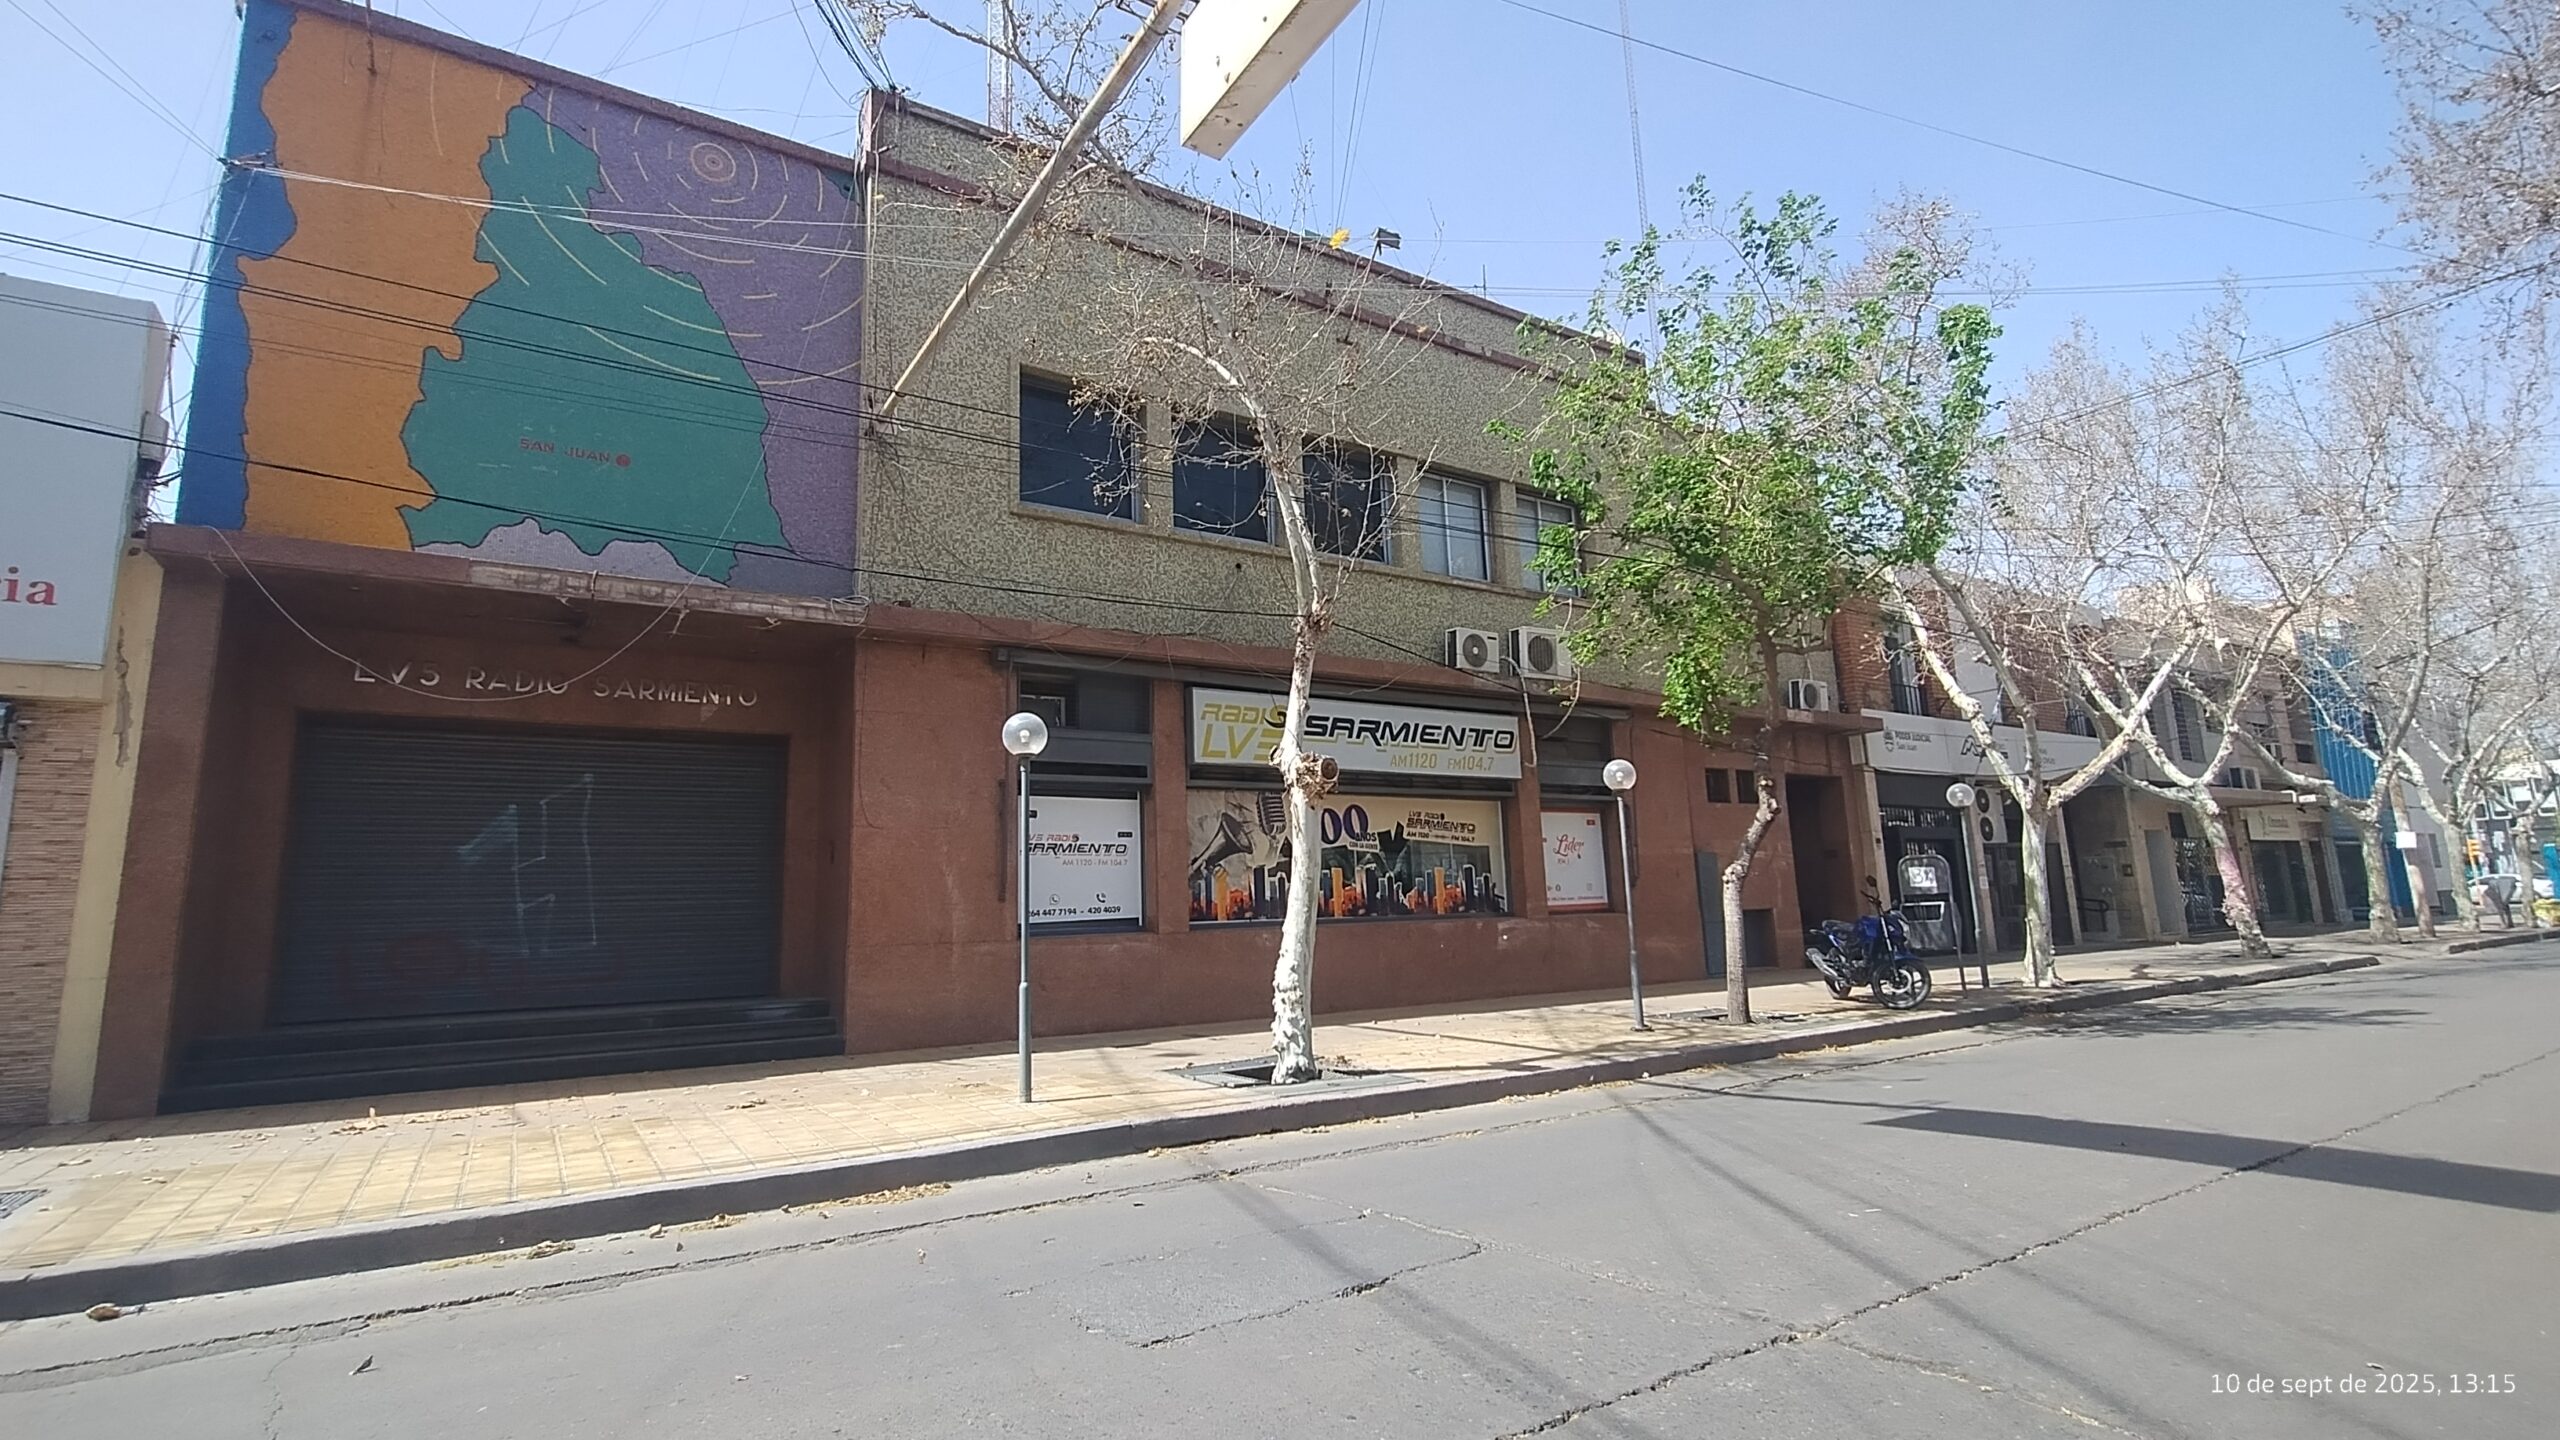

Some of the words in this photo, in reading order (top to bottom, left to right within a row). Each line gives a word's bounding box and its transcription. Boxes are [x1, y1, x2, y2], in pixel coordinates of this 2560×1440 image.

[520, 438, 554, 453] SAN
[565, 447, 610, 462] JUAN
[0, 566, 58, 606] ia
[465, 666, 568, 695] RADIO
[593, 677, 758, 707] SARMIENTO
[1304, 715, 1516, 750] SARMIENTO
[1321, 804, 1368, 844] 00
[1406, 818, 1476, 833] SARMIENTO
[1076, 859, 1092, 867] 1120
[1087, 906, 1101, 914] 420
